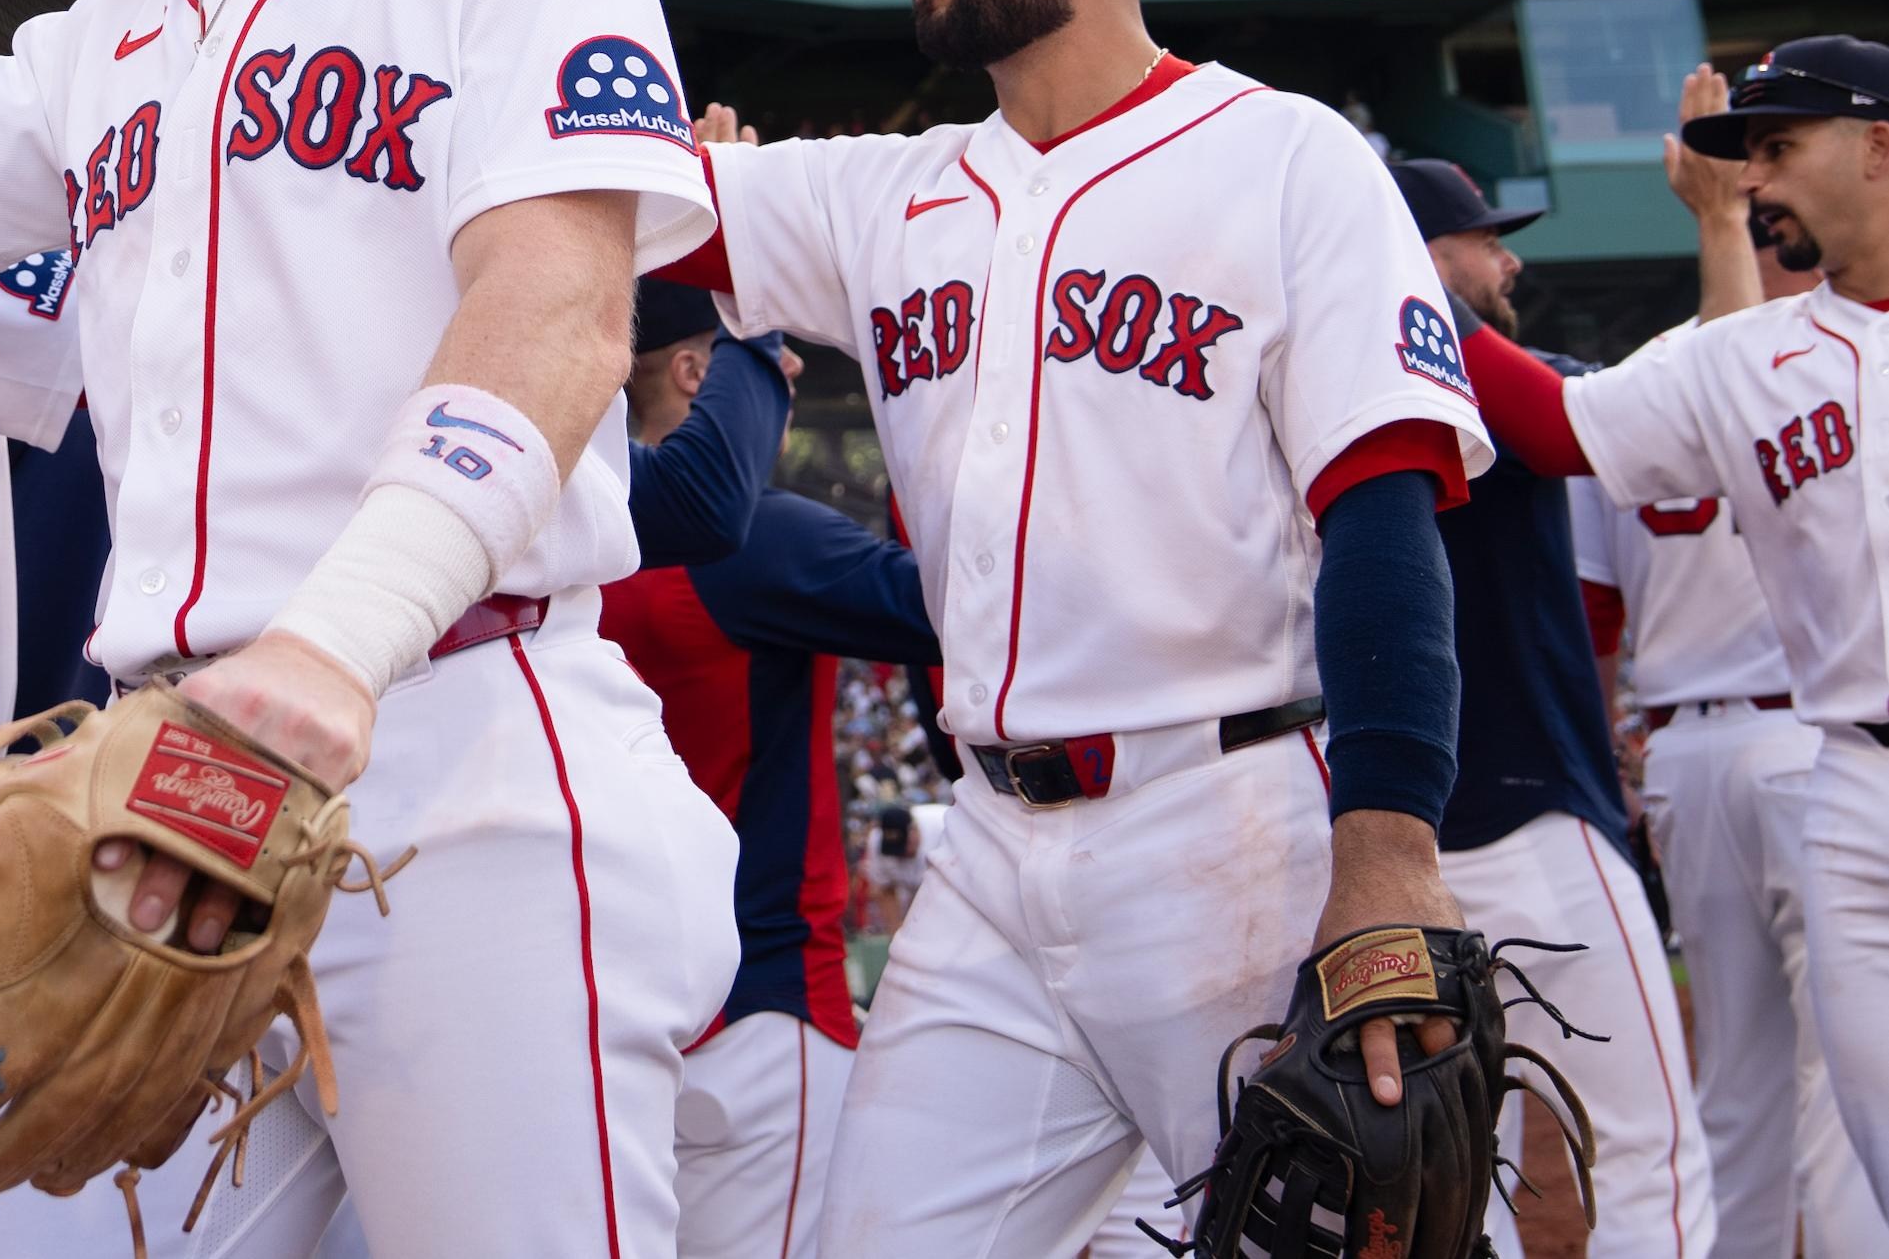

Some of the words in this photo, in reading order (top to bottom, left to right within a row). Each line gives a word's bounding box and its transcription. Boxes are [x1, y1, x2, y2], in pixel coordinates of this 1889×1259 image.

[227, 43, 452, 192] SOX
[554, 108, 694, 147] MassMutual
[35, 249, 73, 314] MassMu
[869, 279, 975, 402] RED
[1044, 268, 1244, 401] SOX
[419, 434, 493, 481] 10
[1753, 400, 1855, 508] RED
[152, 763, 267, 831] Rawlings
[1331, 949, 1420, 998] Rawlings
